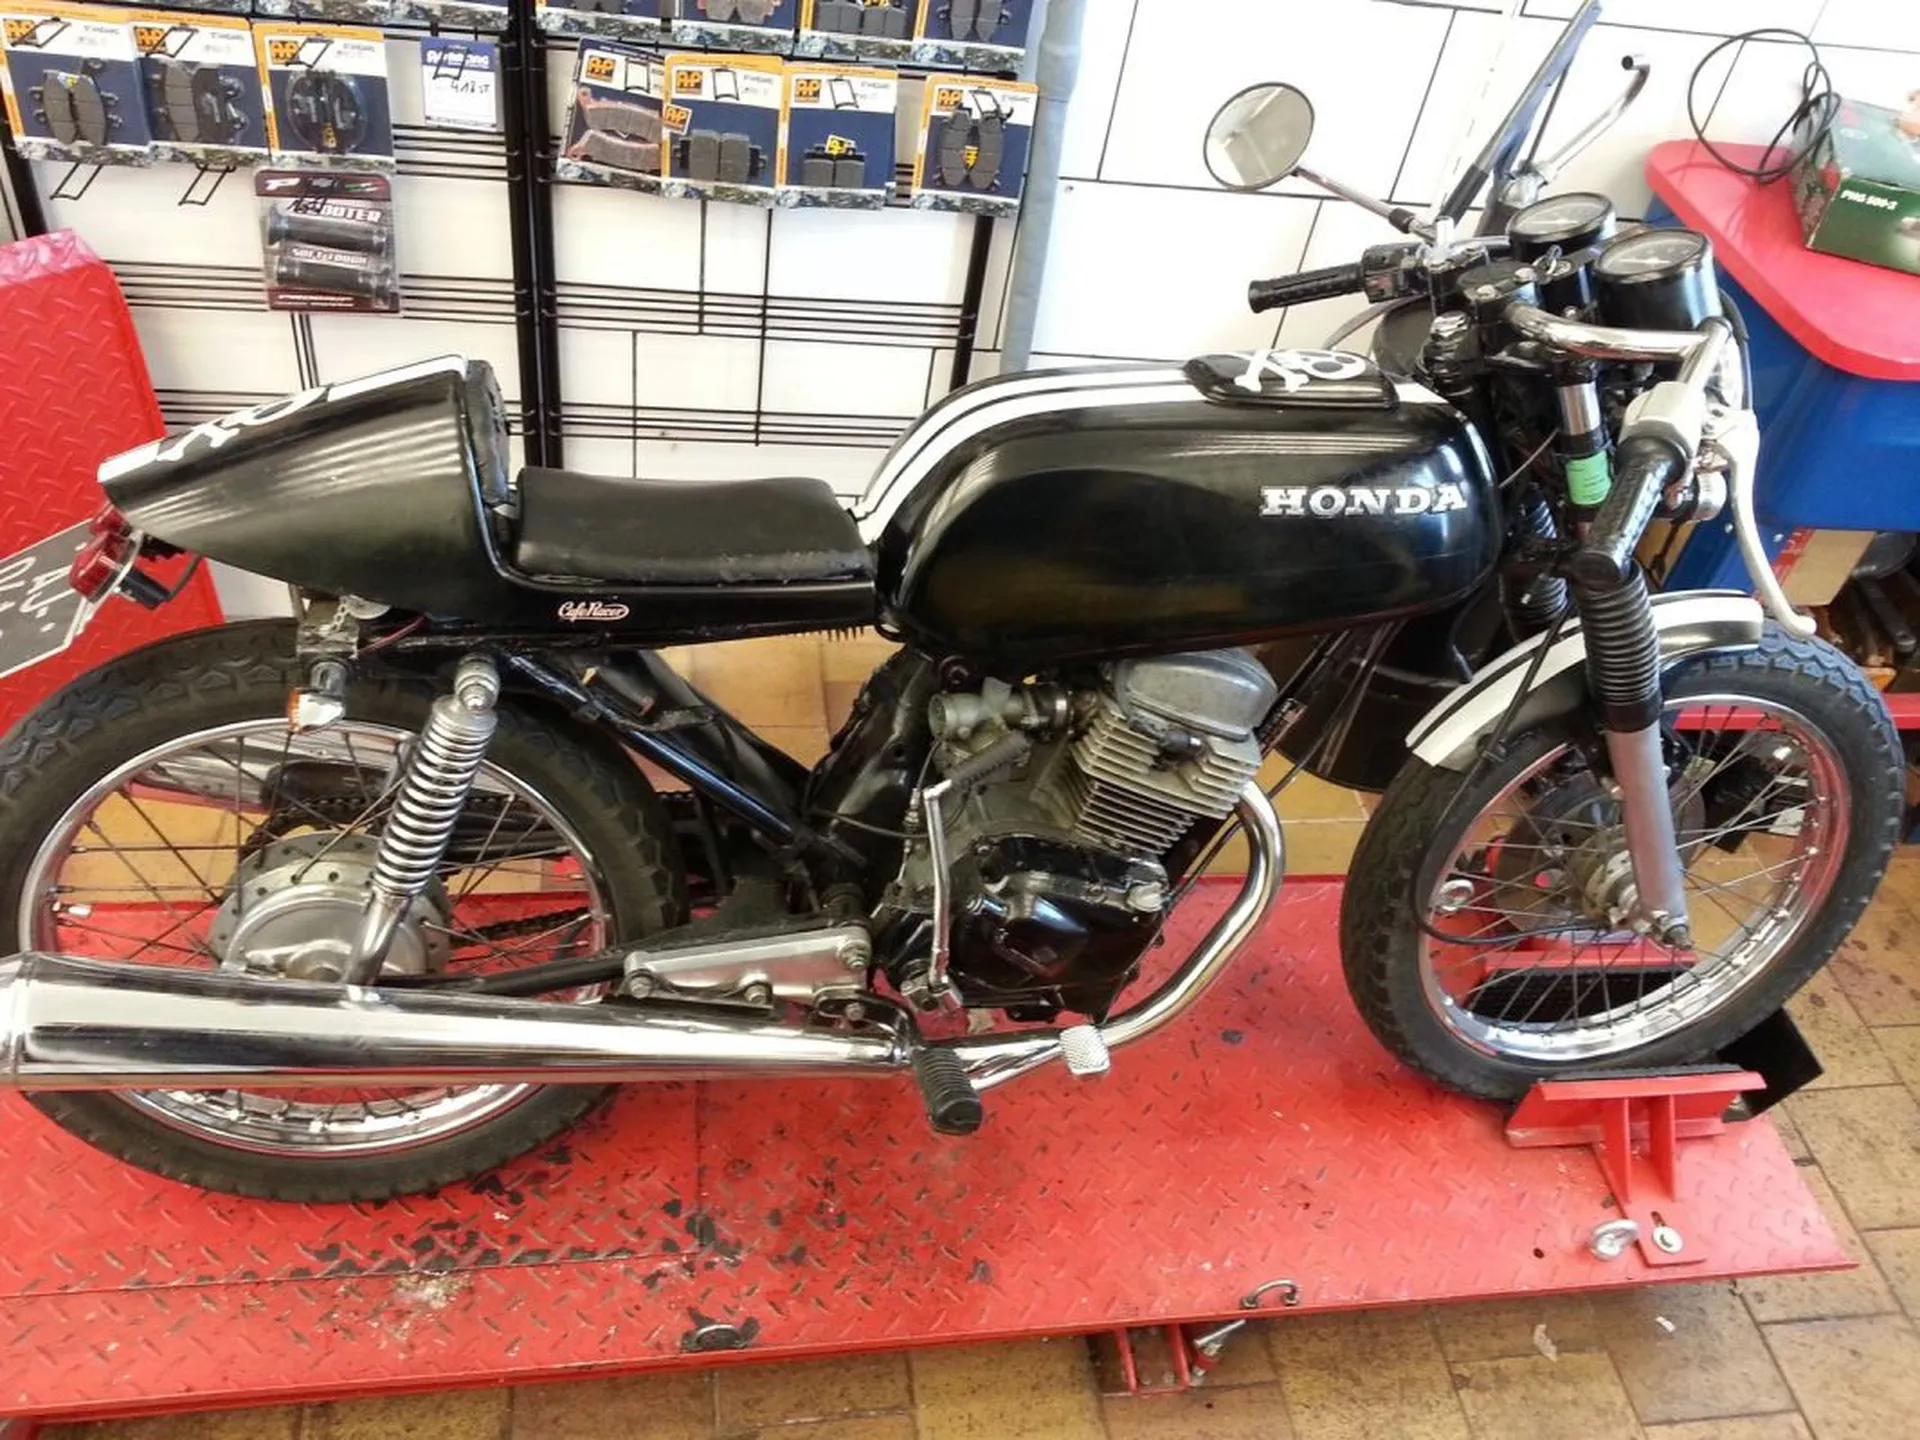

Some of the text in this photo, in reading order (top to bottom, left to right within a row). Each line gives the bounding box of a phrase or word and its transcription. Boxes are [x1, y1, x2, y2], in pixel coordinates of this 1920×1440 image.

[587, 55, 615, 76] AP
[676, 71, 702, 89] AP
[796, 79, 821, 97] AP
[938, 88, 963, 106] AP
[665, 106, 688, 124] AP
[1259, 485, 1468, 518] HONDA
